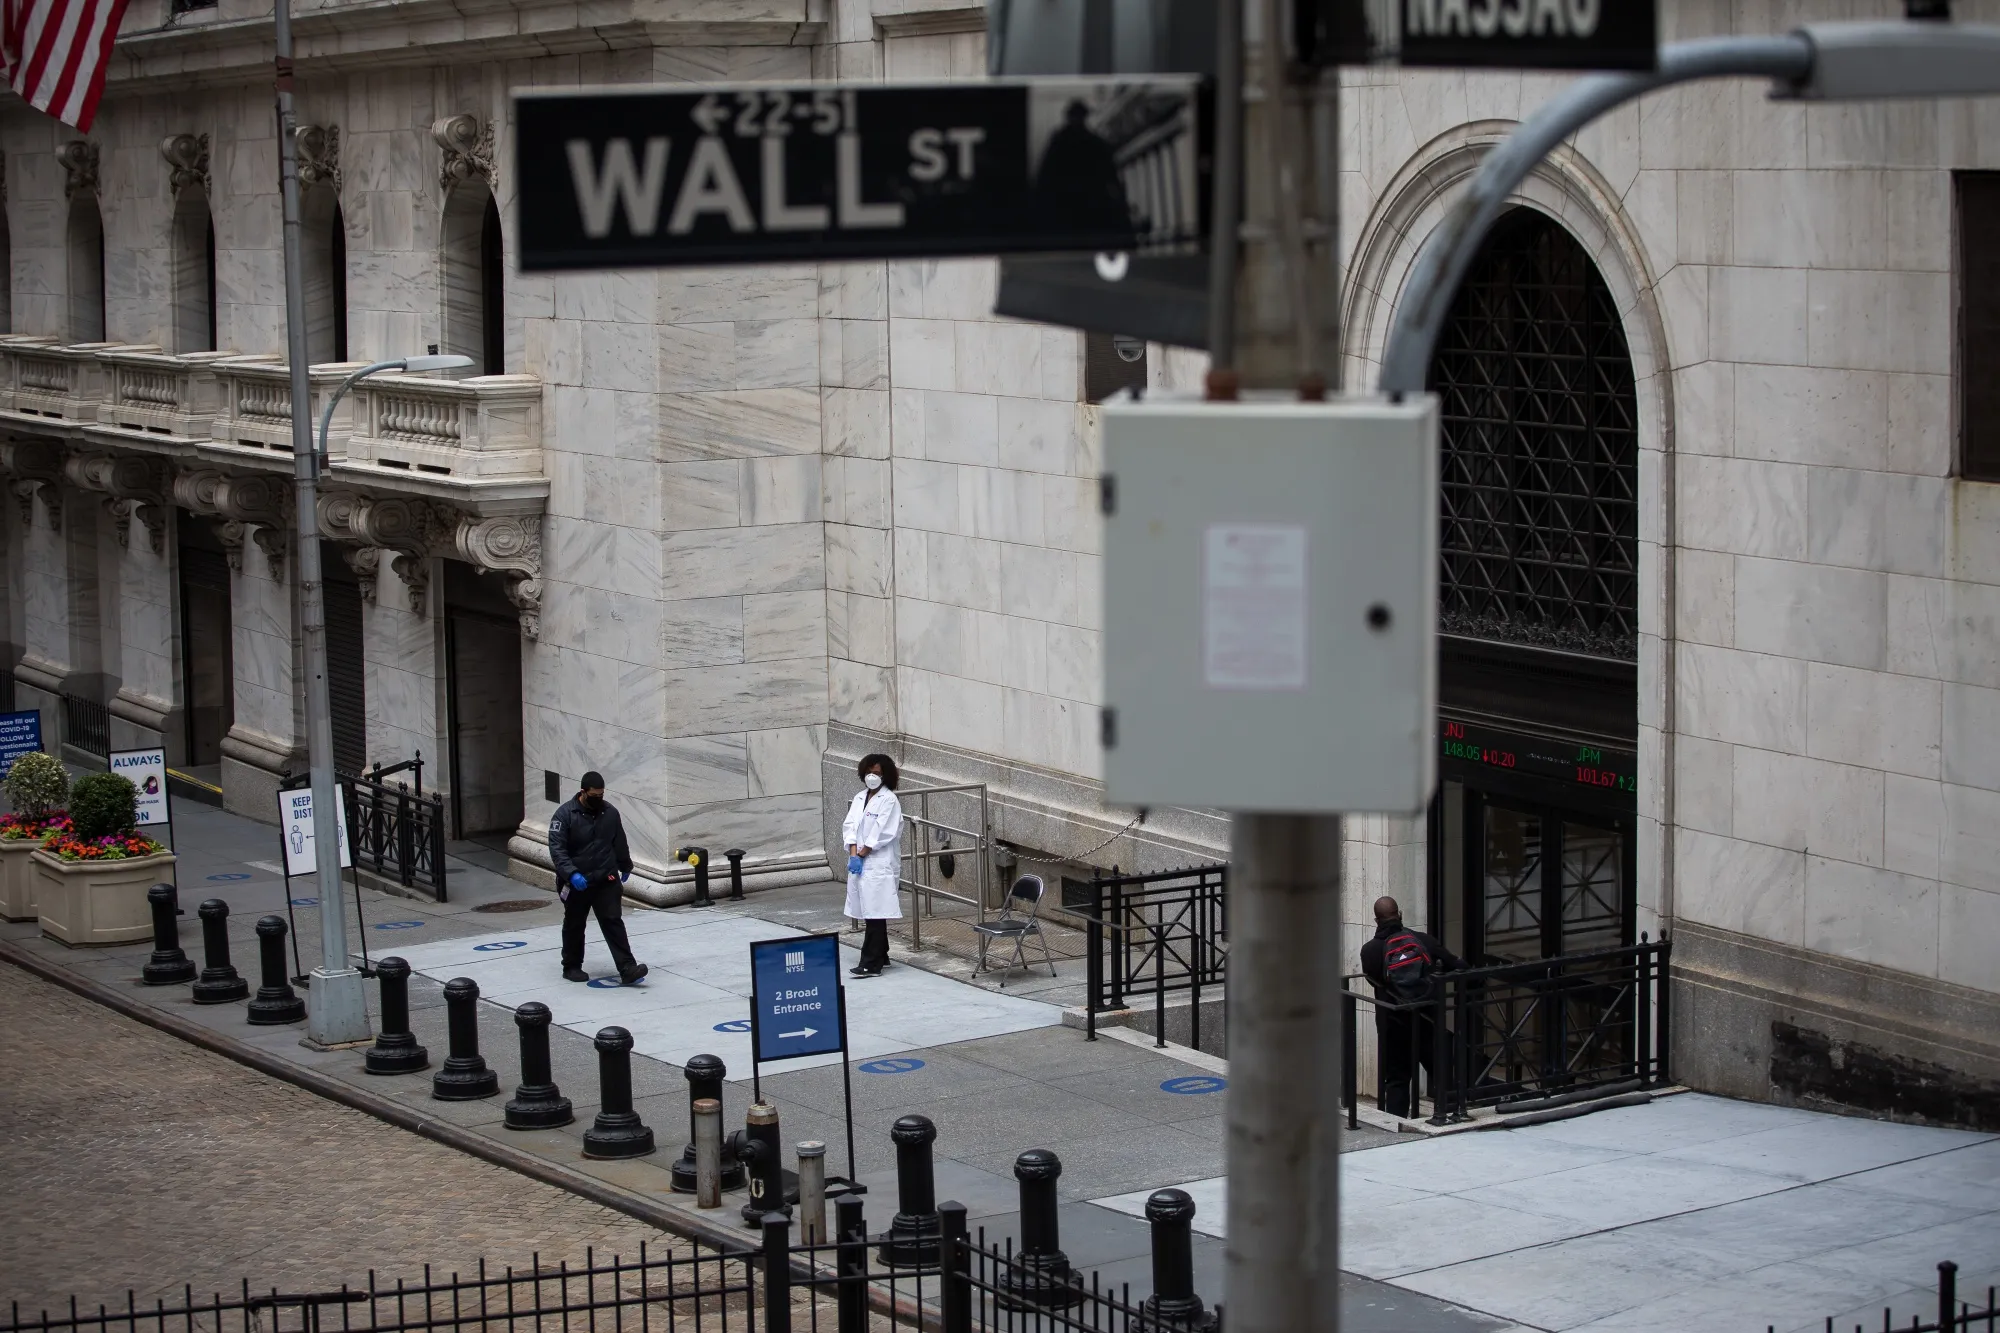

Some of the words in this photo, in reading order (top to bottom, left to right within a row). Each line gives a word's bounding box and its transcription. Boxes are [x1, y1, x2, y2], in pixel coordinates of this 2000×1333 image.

[565, 136, 905, 238] WALL
[908, 126, 986, 181] ST
[0, 725, 30, 734] COVID-19
[1444, 721, 1465, 739] JNJ
[1577, 746, 1601, 764] JPM
[113, 754, 161, 768] ALWAYS
[1444, 741, 1480, 761] 148.05
[1491, 750, 1515, 767] 0.20
[1576, 766, 1616, 787] 101.67
[292, 795, 311, 807] KEEP
[293, 807, 312, 819] DIST
[786, 964, 805, 973] NYSE
[775, 991, 783, 1001] 2
[785, 986, 818, 999] Broad
[773, 1002, 821, 1014] Entrance
